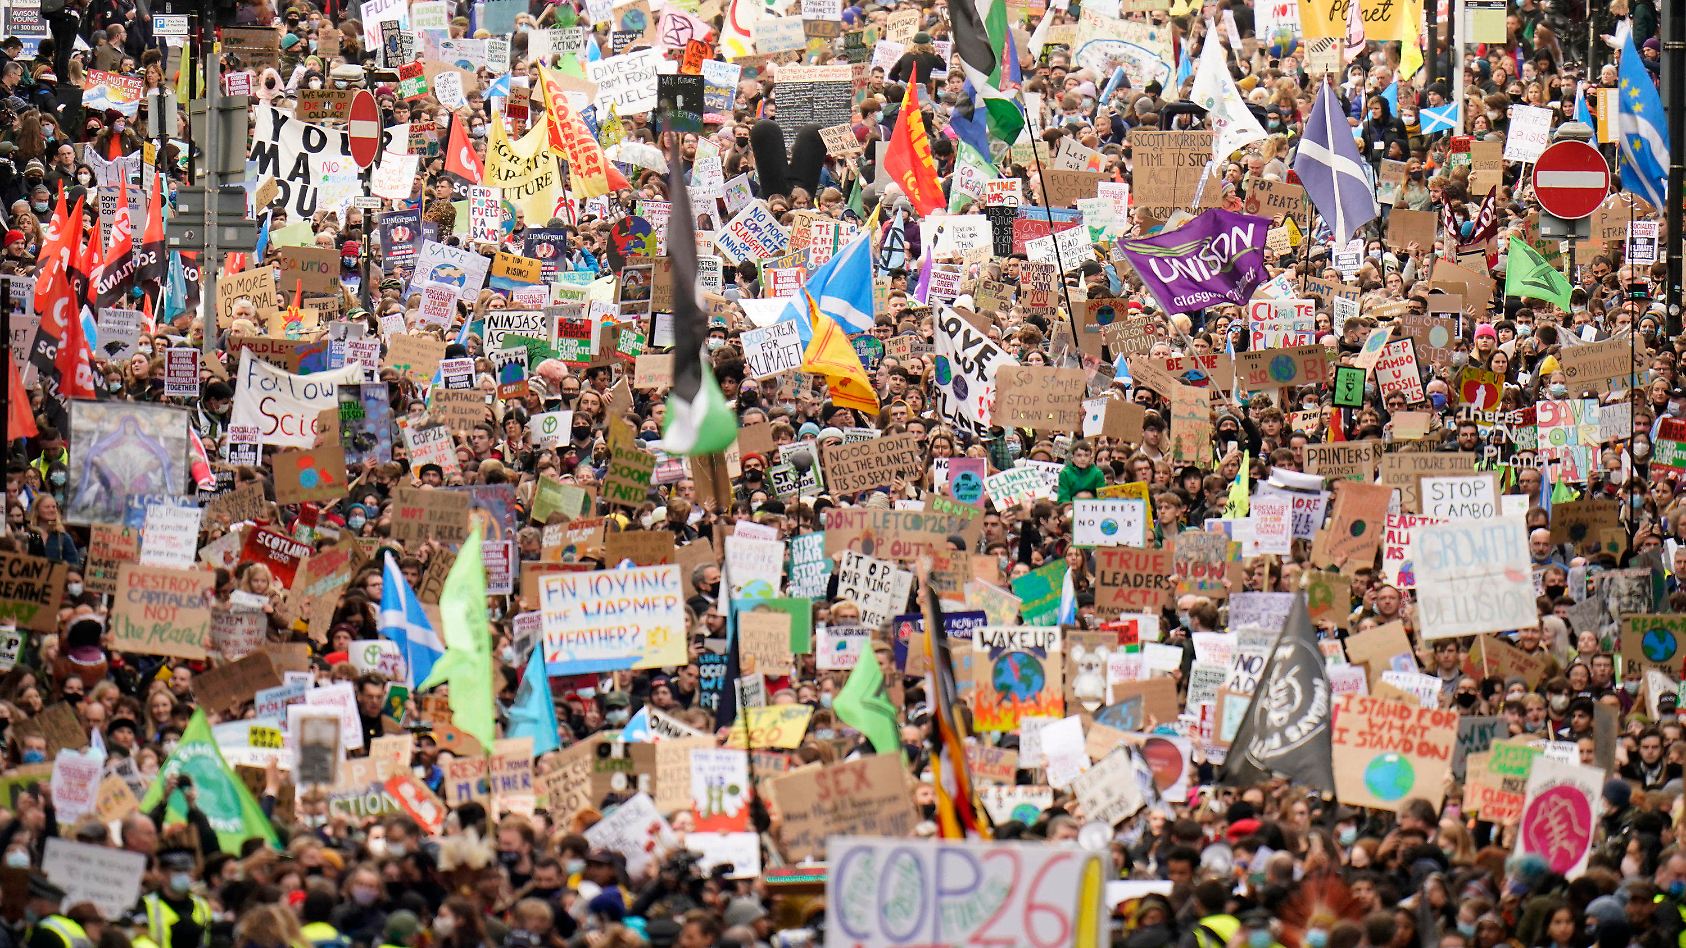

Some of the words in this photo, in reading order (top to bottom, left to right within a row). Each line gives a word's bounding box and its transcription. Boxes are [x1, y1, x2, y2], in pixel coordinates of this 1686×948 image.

[566, 40, 582, 50] NOW
[593, 54, 650, 82] DIVEST
[301, 91, 313, 99] WE
[336, 91, 346, 99] TO
[600, 83, 657, 110] FUELS
[335, 102, 348, 111] OF
[1134, 134, 1167, 147] SCOTT
[1168, 134, 1214, 147] MORRISO
[1138, 153, 1165, 167] TIME
[1172, 152, 1185, 167] TO
[473, 188, 491, 197] END
[987, 182, 1017, 192] TIME
[1253, 179, 1273, 191] FOR
[750, 206, 767, 223] NO
[764, 222, 790, 247] MORE
[430, 244, 465, 264] SAVE
[739, 240, 751, 252] OF
[1148, 222, 1254, 284] UNISON
[1065, 254, 1090, 269] HERE
[221, 283, 233, 297] NO
[238, 273, 268, 292] MORE
[932, 272, 960, 282] SOCIALIST
[936, 280, 954, 288] GREEN
[426, 289, 455, 299] SOCIALIST
[428, 294, 451, 303] CHANGE
[488, 315, 538, 330] NINJAS
[558, 339, 579, 348] FUND
[620, 336, 645, 352] CLIMATE
[621, 329, 638, 343] FUND
[348, 341, 378, 351] SOCIALIST
[558, 346, 591, 355] CLIMATE
[747, 343, 802, 376] KLIMATET
[1166, 357, 1183, 372] BE
[1191, 355, 1218, 370] THE
[1375, 355, 1414, 371] CAMBO
[1392, 370, 1402, 380] U
[1381, 377, 1421, 396] FOSSIL
[1007, 394, 1040, 407] STOP
[1538, 400, 1600, 427] SAVE
[230, 426, 259, 435] SOCIALIST
[412, 430, 444, 446] COP26
[1550, 428, 1599, 446] OUR
[1655, 440, 1678, 450] FUND
[831, 461, 855, 477] KILL
[856, 457, 874, 470] THE
[876, 451, 916, 467] PLANET
[1308, 448, 1371, 466] PAINTERS
[988, 468, 1039, 490] CLIMATE
[1317, 466, 1356, 475] AGAINST
[852, 476, 866, 490] SO
[870, 469, 893, 485] SEXY
[992, 481, 1045, 501] JUSTICE
[1431, 480, 1486, 501] STOP
[1082, 504, 1136, 513] THERE'S
[1434, 503, 1494, 520] CAMBO
[826, 512, 868, 530] DON'T
[872, 512, 902, 530] LET
[257, 530, 310, 558] SCOTLAND
[792, 534, 823, 548] STOP
[1418, 522, 1519, 571] GROWTH
[793, 548, 823, 565] WAR
[1102, 551, 1164, 570] TRUE
[792, 562, 826, 578] STOP
[846, 552, 890, 579] STOP
[128, 571, 200, 592] DESTROY
[1101, 571, 1171, 590] LEADERS
[128, 591, 213, 608] CAPITALISM
[580, 596, 678, 618] WARMER
[144, 605, 180, 621] NOT
[978, 631, 1034, 649] WAKE
[1034, 632, 1056, 648] UP
[1358, 700, 1413, 721] STAND
[1417, 708, 1458, 730] FOR
[1367, 716, 1432, 738] WHAT
[1355, 730, 1413, 755] STAND
[1416, 742, 1449, 761] ON
[814, 762, 873, 802] SEX
[835, 845, 1074, 948] COP26
